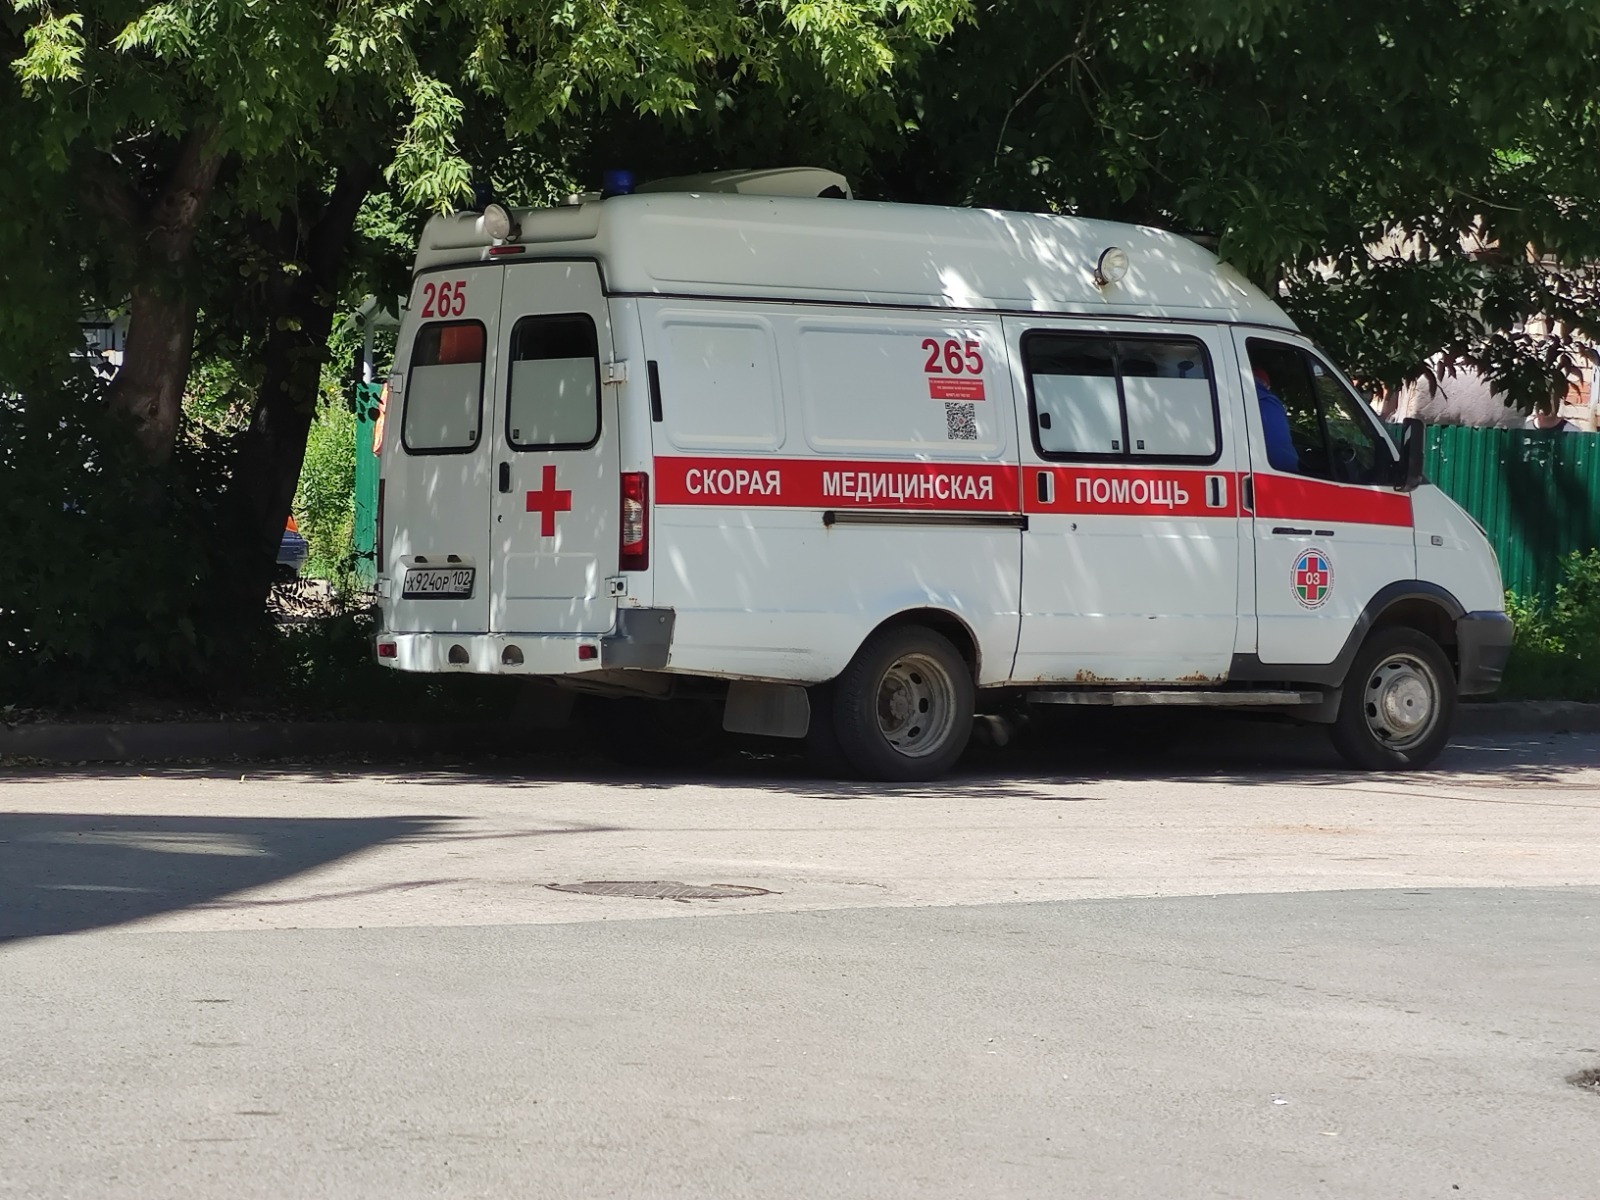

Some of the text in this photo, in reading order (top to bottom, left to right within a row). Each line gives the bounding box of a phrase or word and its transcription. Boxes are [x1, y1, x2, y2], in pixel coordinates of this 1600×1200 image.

[421, 281, 466, 318] 265
[921, 338, 984, 374] 265
[686, 468, 1190, 510] СКОРАЯ МЕДИЦИНСКАЯ ПОМОЩЬ
[1306, 572, 1320, 585] 03
